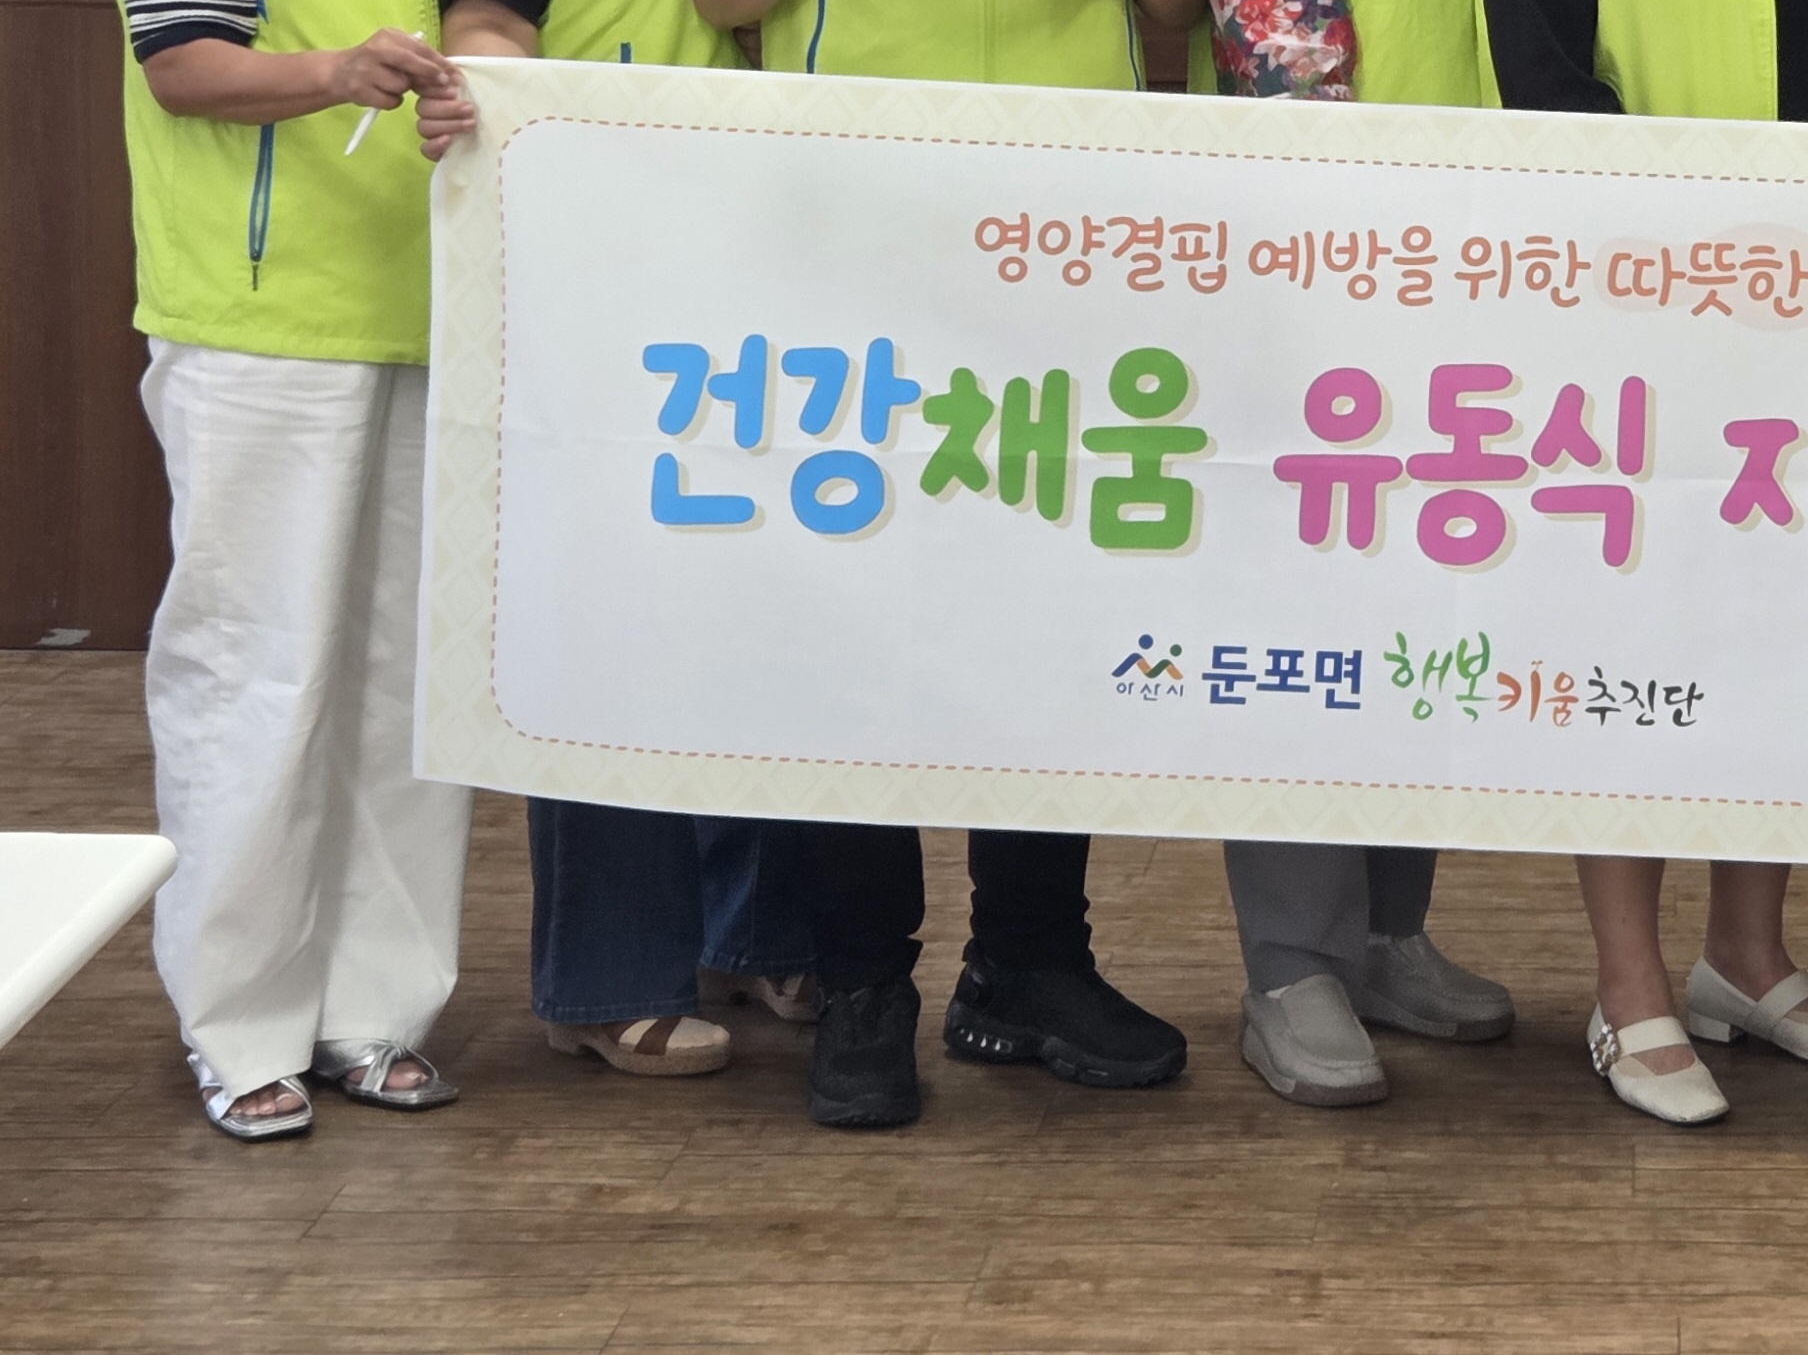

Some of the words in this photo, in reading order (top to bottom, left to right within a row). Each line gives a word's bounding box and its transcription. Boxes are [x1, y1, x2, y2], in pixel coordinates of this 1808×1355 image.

[972, 214, 1228, 292] 영양결핍
[1247, 225, 1438, 306] 예방을
[1454, 235, 1592, 308] 위한
[642, 334, 1208, 550] 건강채움
[1273, 365, 1647, 567] 유동식
[1114, 680, 1185, 702] 아산시
[1201, 645, 1364, 710] 둔포면
